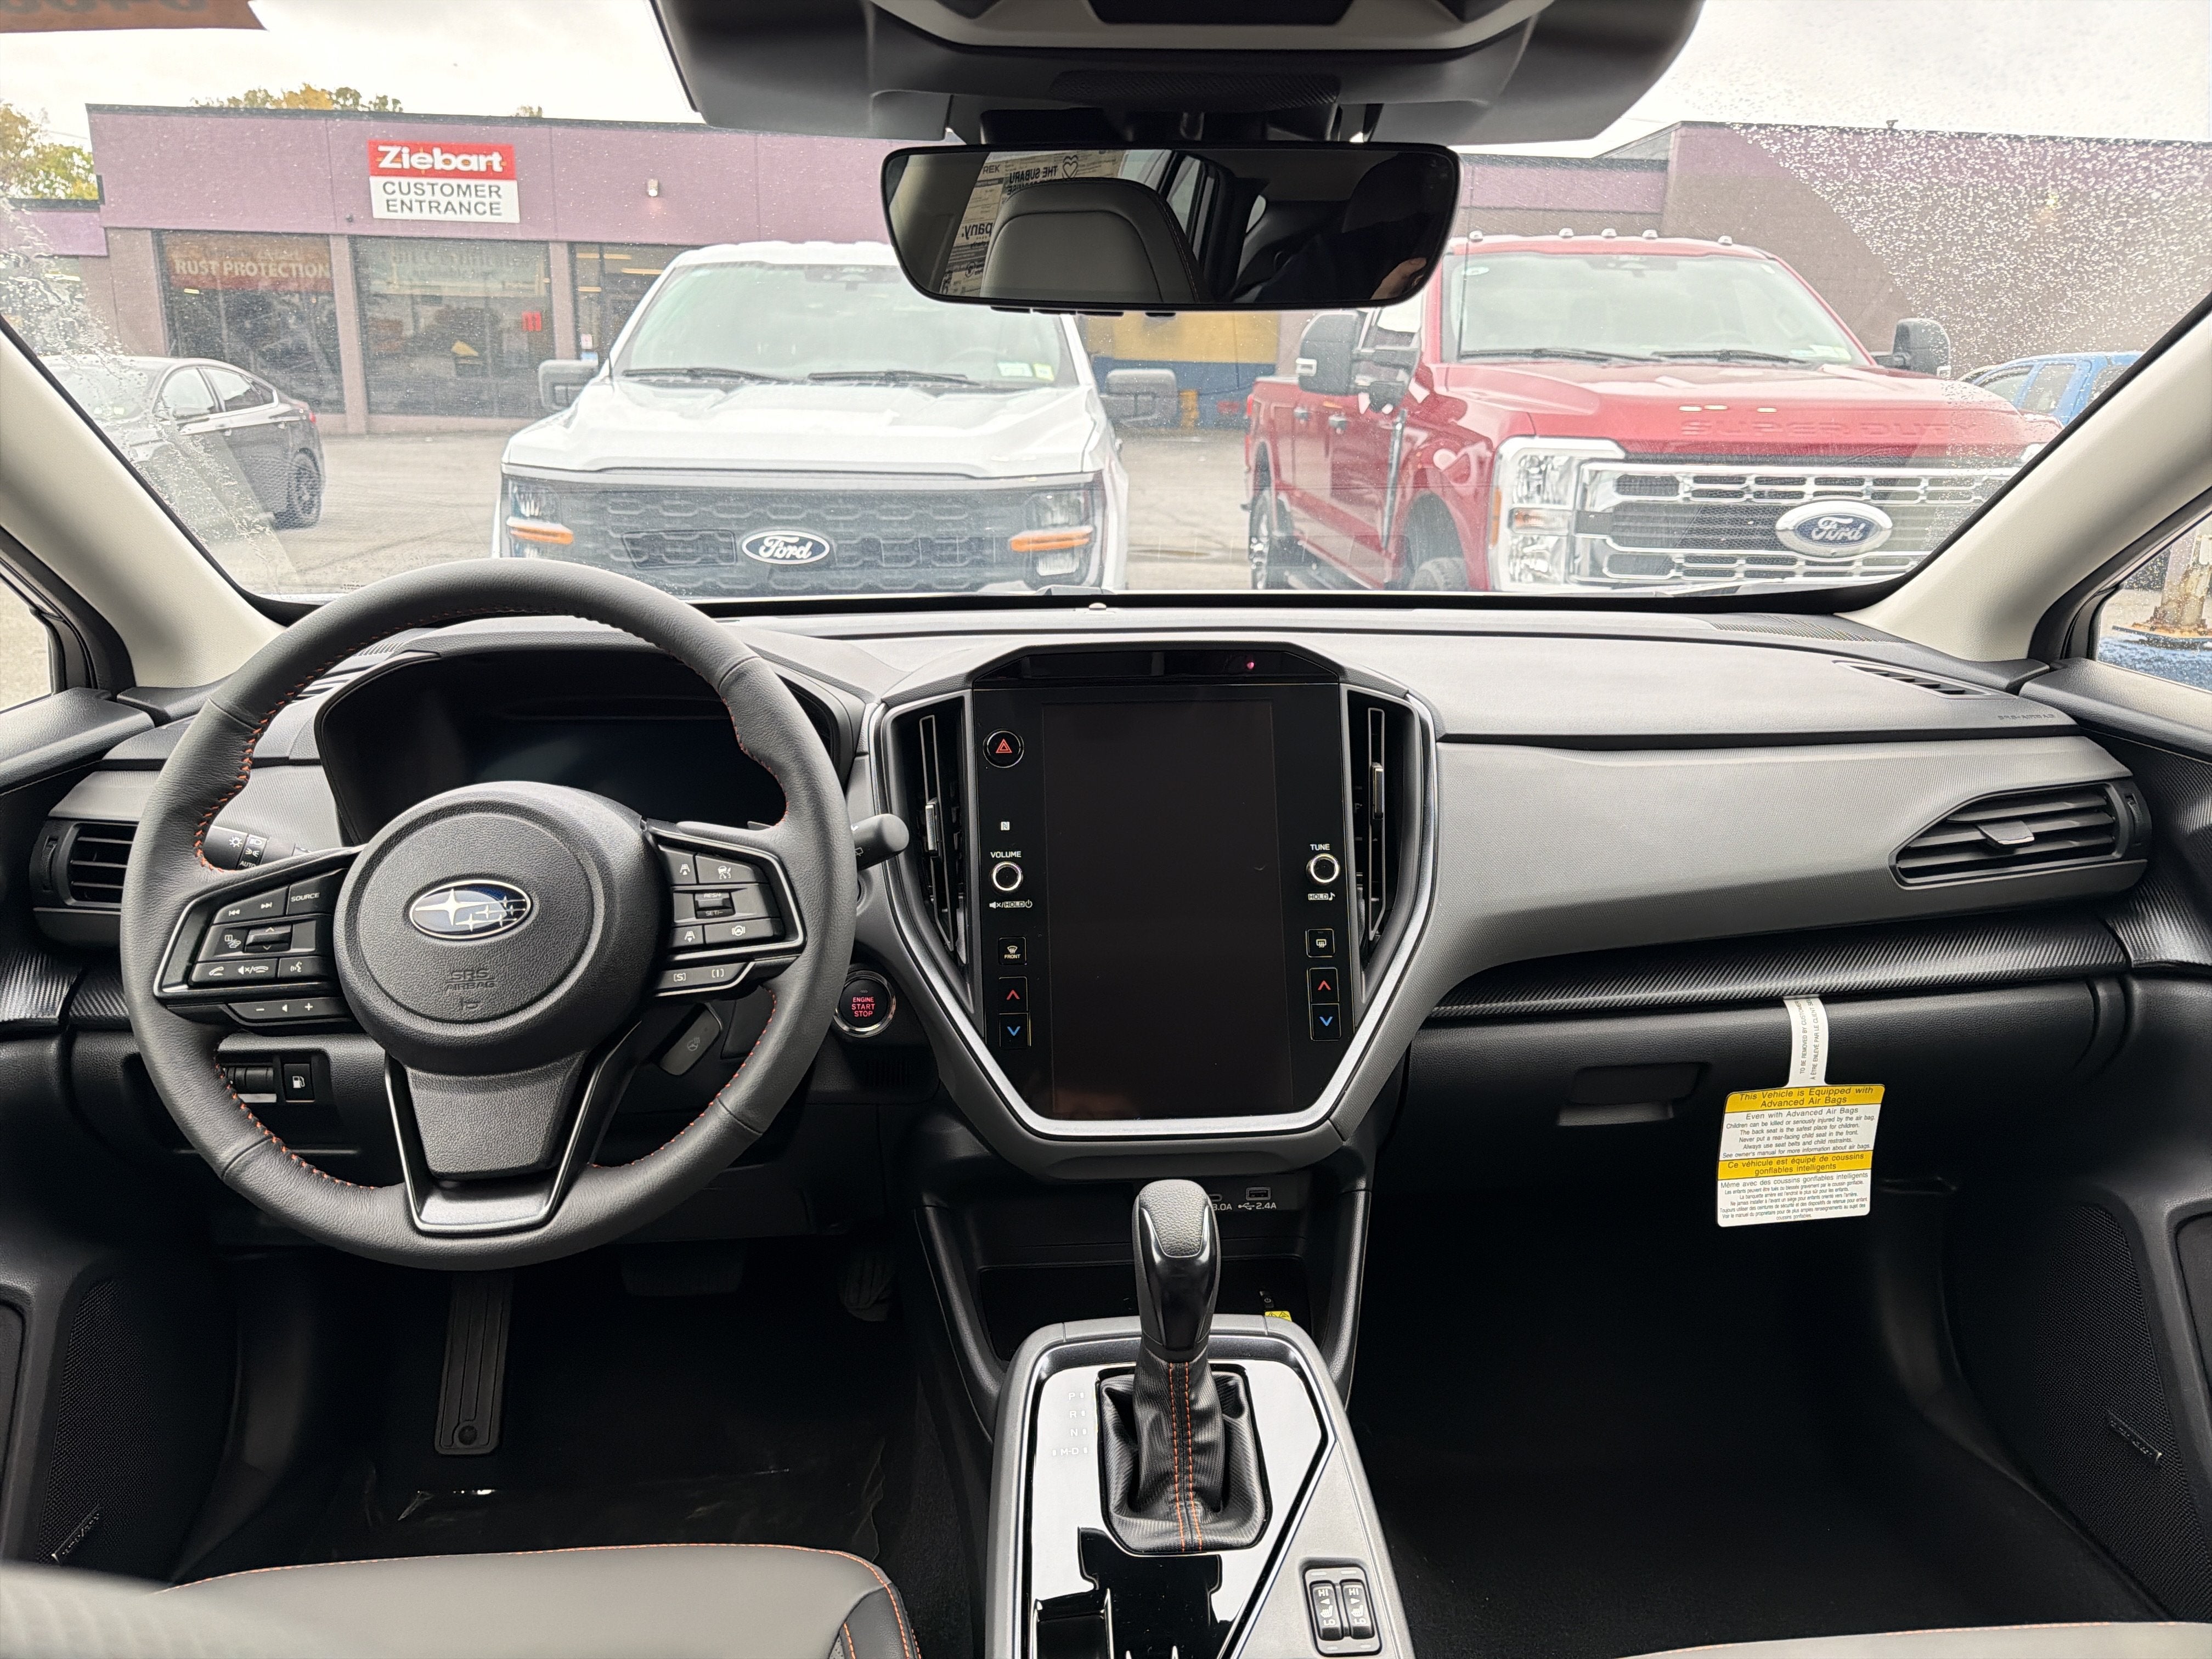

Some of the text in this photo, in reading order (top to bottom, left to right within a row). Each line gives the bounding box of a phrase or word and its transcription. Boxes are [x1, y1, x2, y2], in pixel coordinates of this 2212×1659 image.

[377, 145, 503, 172] Ziebart
[382, 181, 502, 199] CUSTOMER
[386, 199, 503, 216] ENTRANCE
[174, 259, 330, 278] RUST PROTECTION
[1812, 516, 1866, 541] Ford
[759, 535, 814, 559] Ford
[291, 892, 320, 902] SOURCE
[451, 970, 489, 980] SRS
[1794, 1001, 1807, 1025] CUSTOMER
[1810, 1007, 1819, 1024] CLIENT
[1762, 1091, 1792, 1099] Vehicle
[1809, 1088, 1850, 1098] Equipped
[1761, 1099, 1804, 1108] Advanced
[1791, 1156, 1815, 1165] équipé
[1754, 1163, 1836, 1175] gonflables intelligents
[1803, 1175, 1833, 1184] gonflables
[1836, 1172, 1867, 1180] intelligents
[1068, 1392, 1076, 1401] P
[1070, 1410, 1077, 1419] R
